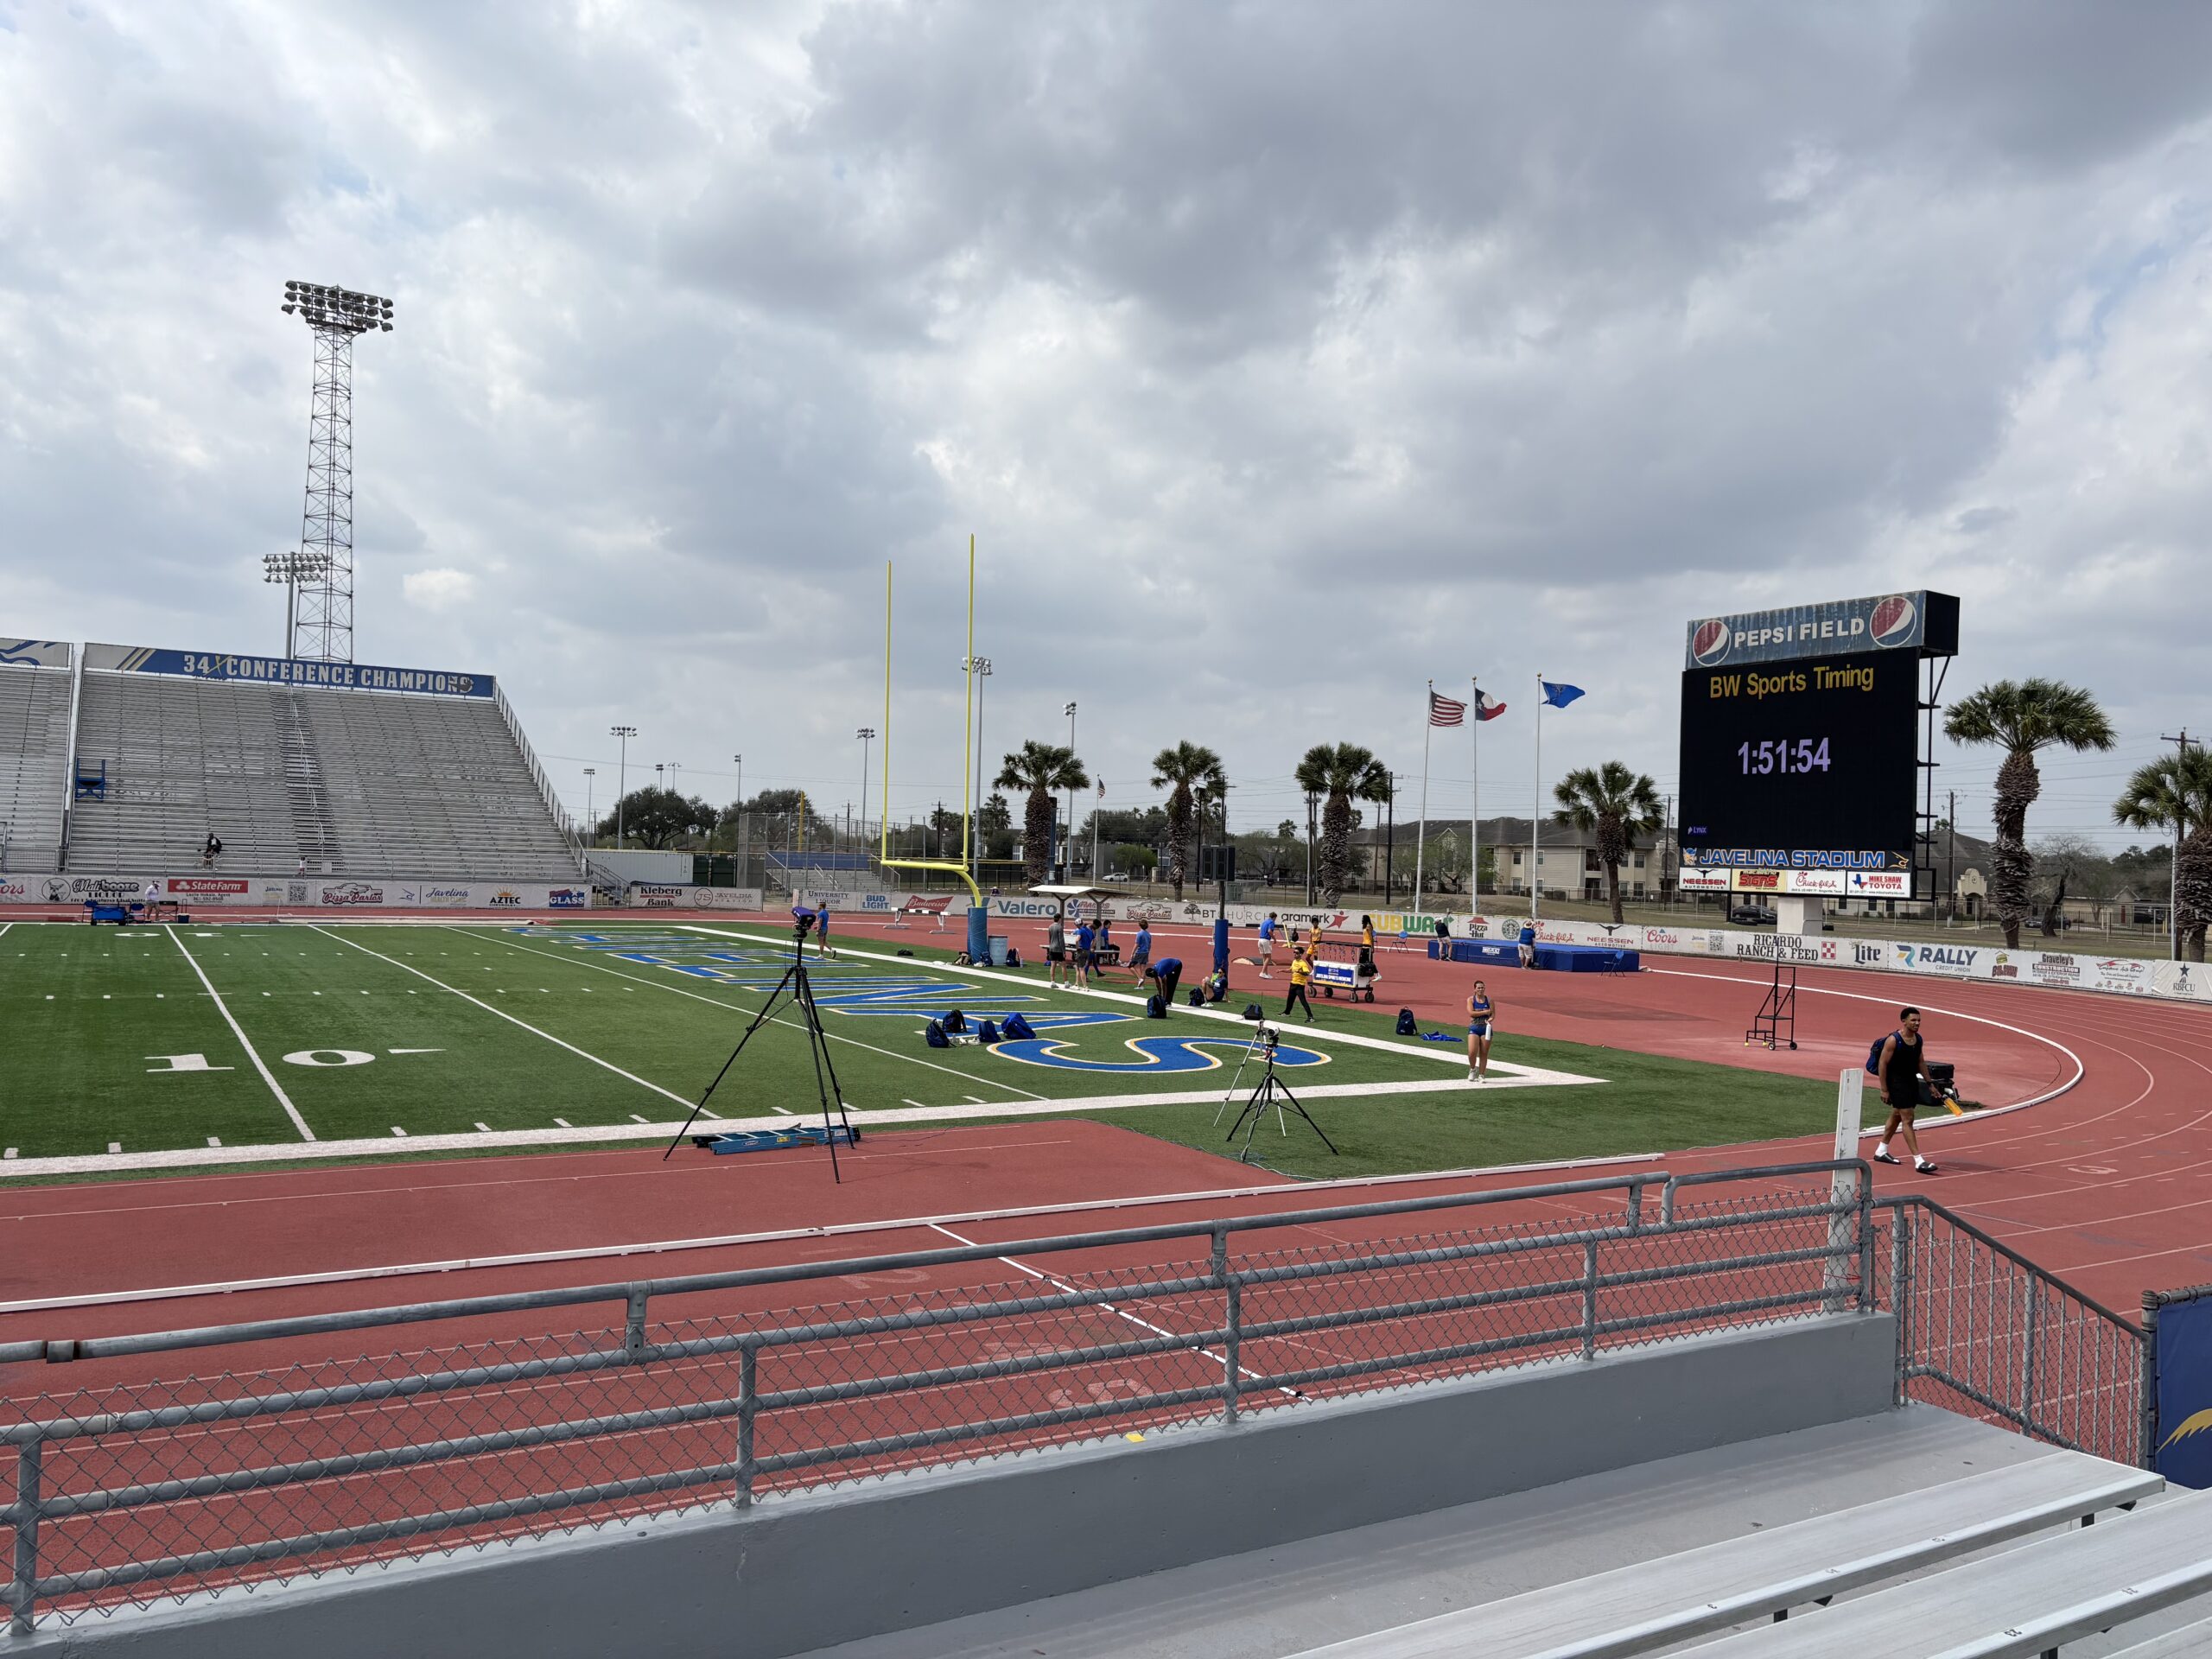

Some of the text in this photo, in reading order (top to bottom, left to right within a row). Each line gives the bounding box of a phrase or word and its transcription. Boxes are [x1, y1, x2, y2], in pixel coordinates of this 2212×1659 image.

[1734, 618, 1865, 648] PEPSI FIELD
[226, 658, 354, 685] CONFERENCE
[1710, 664, 1874, 699] BW Sports Timing
[1738, 737, 1831, 775] 1:51:54
[1700, 849, 1885, 869] JAVELINA STADIUM
[0, 884, 25, 894] ors
[426, 887, 469, 899] Javelina
[640, 887, 682, 896] Kleberg
[550, 896, 584, 905] GLASS
[908, 899, 950, 907] Budweiser
[998, 900, 1058, 916] Valero
[1281, 912, 1331, 924] aramark
[1470, 930, 1484, 938] Hut
[1647, 930, 1678, 944] Coors
[1754, 934, 1802, 948] RICARDO
[1737, 944, 1818, 961] RANCH & FEED
[1854, 944, 1881, 964] Lite
[1919, 947, 1977, 966] RALLY
[2034, 963, 2079, 973] CONSTRUCTION
